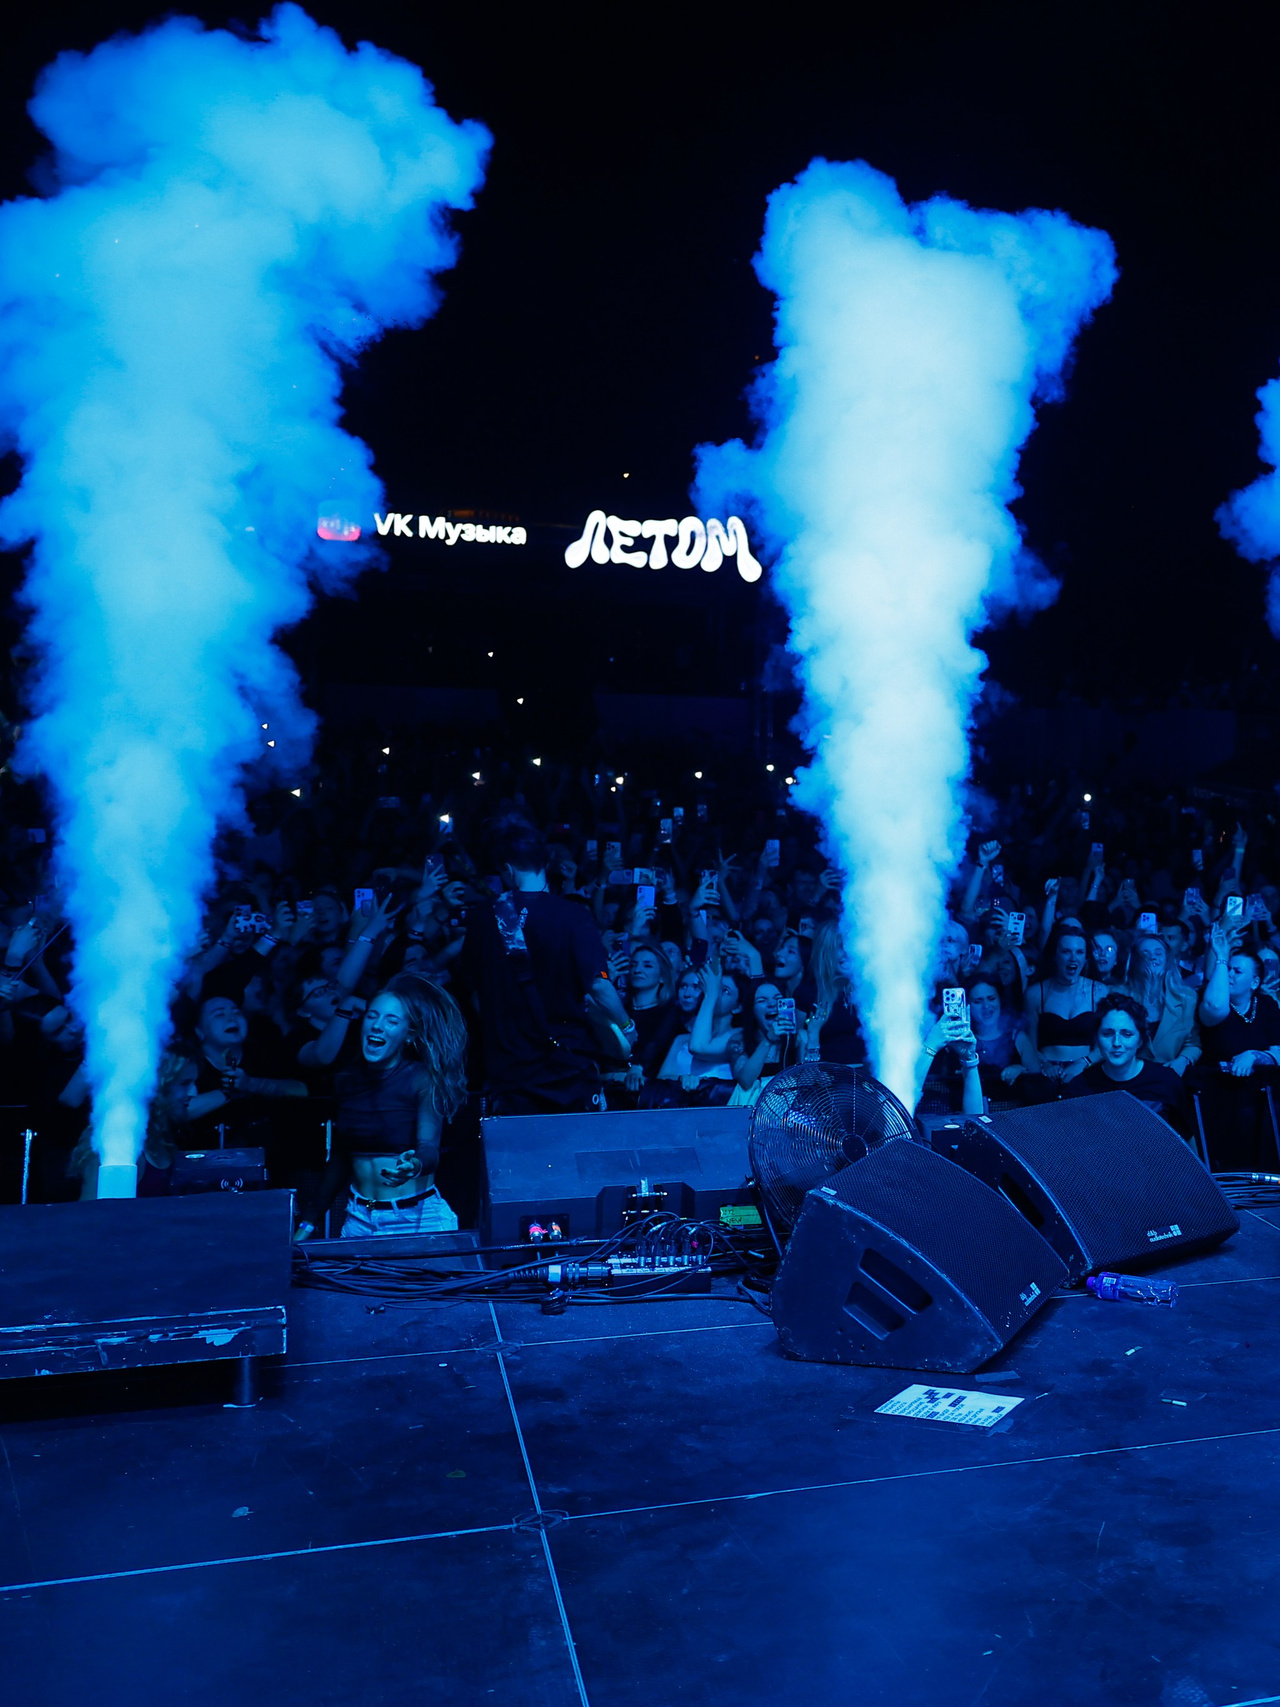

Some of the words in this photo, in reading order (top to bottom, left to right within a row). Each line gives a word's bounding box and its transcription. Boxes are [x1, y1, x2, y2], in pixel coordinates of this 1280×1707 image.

[373, 512, 413, 538] VK
[418, 515, 527, 545] Музыка
[564, 510, 762, 583] ЛЕТОМ
